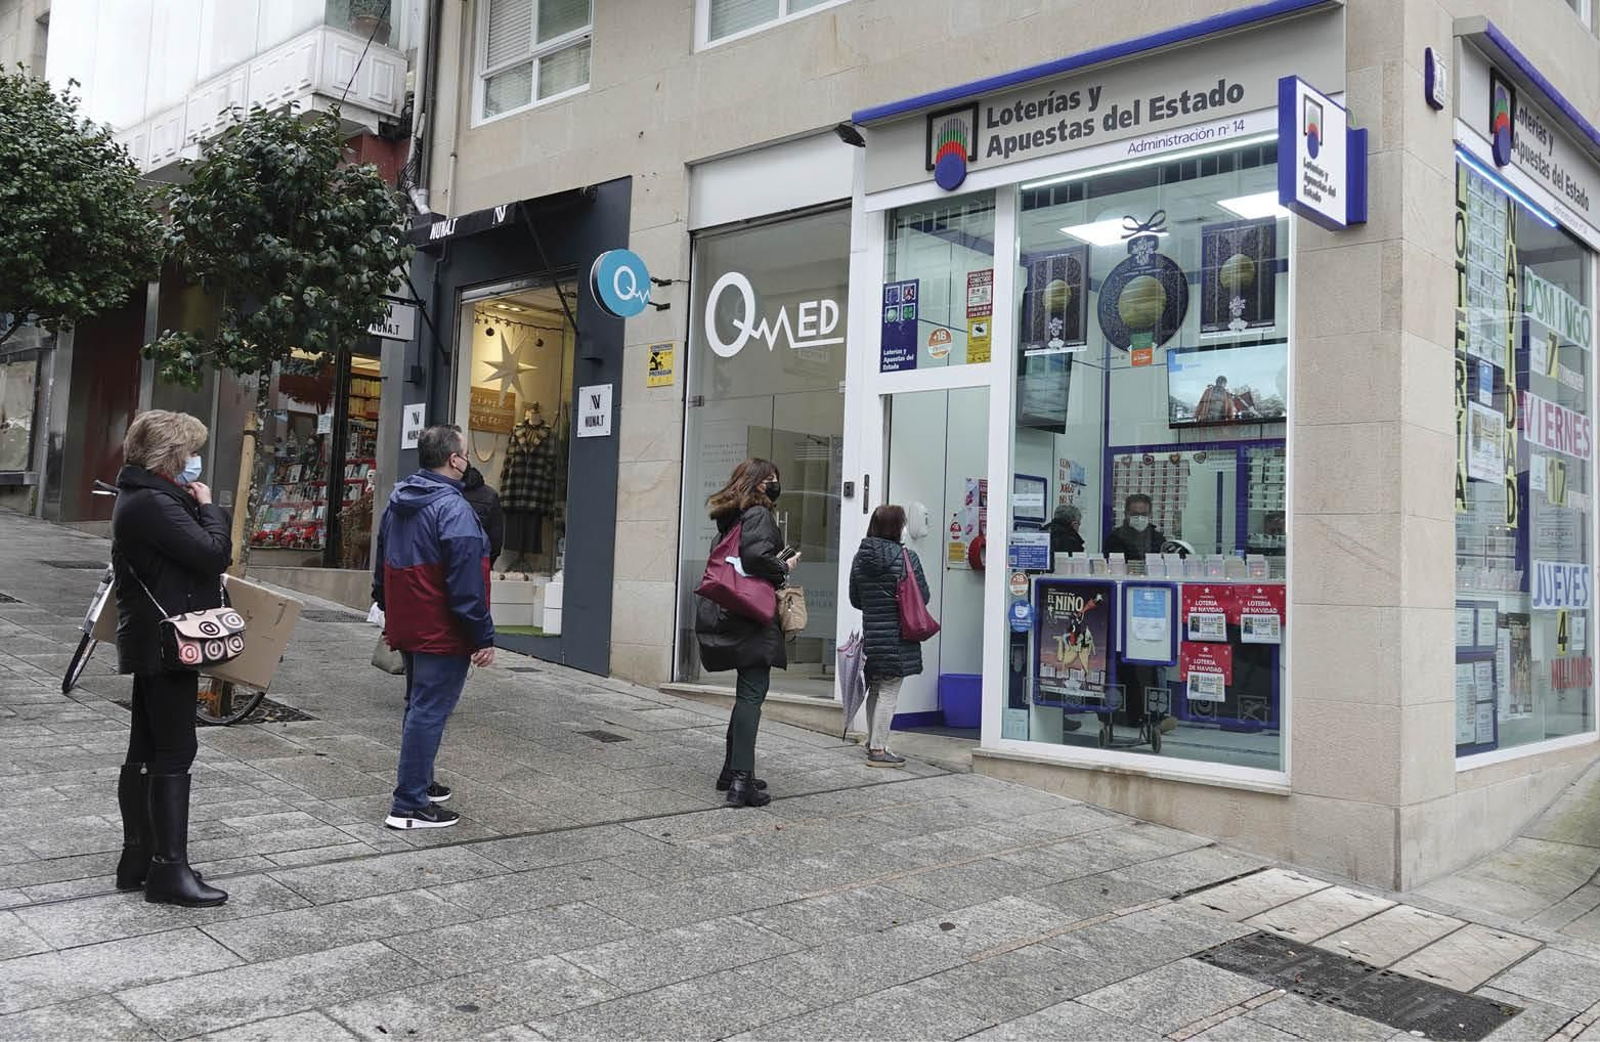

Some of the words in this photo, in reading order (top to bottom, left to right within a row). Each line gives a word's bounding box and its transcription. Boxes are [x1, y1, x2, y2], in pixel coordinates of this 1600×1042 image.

[986, 117, 1095, 159] Apuestas
[1102, 99, 1140, 132] del
[1149, 79, 1245, 122] Estado
[987, 90, 1081, 130] Loterías
[1088, 85, 1103, 113] y
[1513, 103, 1548, 146] Loterías
[1549, 132, 1554, 157] y
[1127, 127, 1214, 155] Administración
[1233, 119, 1245, 133] 14
[1513, 129, 1550, 181] Apuestas
[1552, 163, 1564, 191] del
[1565, 174, 1590, 212] Estado
[1525, 270, 1592, 348] DOMINGO
[1506, 193, 1518, 524] NAVIDAD
[1548, 332, 1558, 375] 7
[1524, 393, 1591, 459] VIERNES
[1549, 459, 1566, 504] 17
[1047, 594, 1054, 603] EL
[1055, 592, 1084, 612] NIÑO
[1533, 563, 1590, 607] JUEVES
[1557, 611, 1569, 652] 4
[1196, 665, 1223, 673] NAVIDAD
